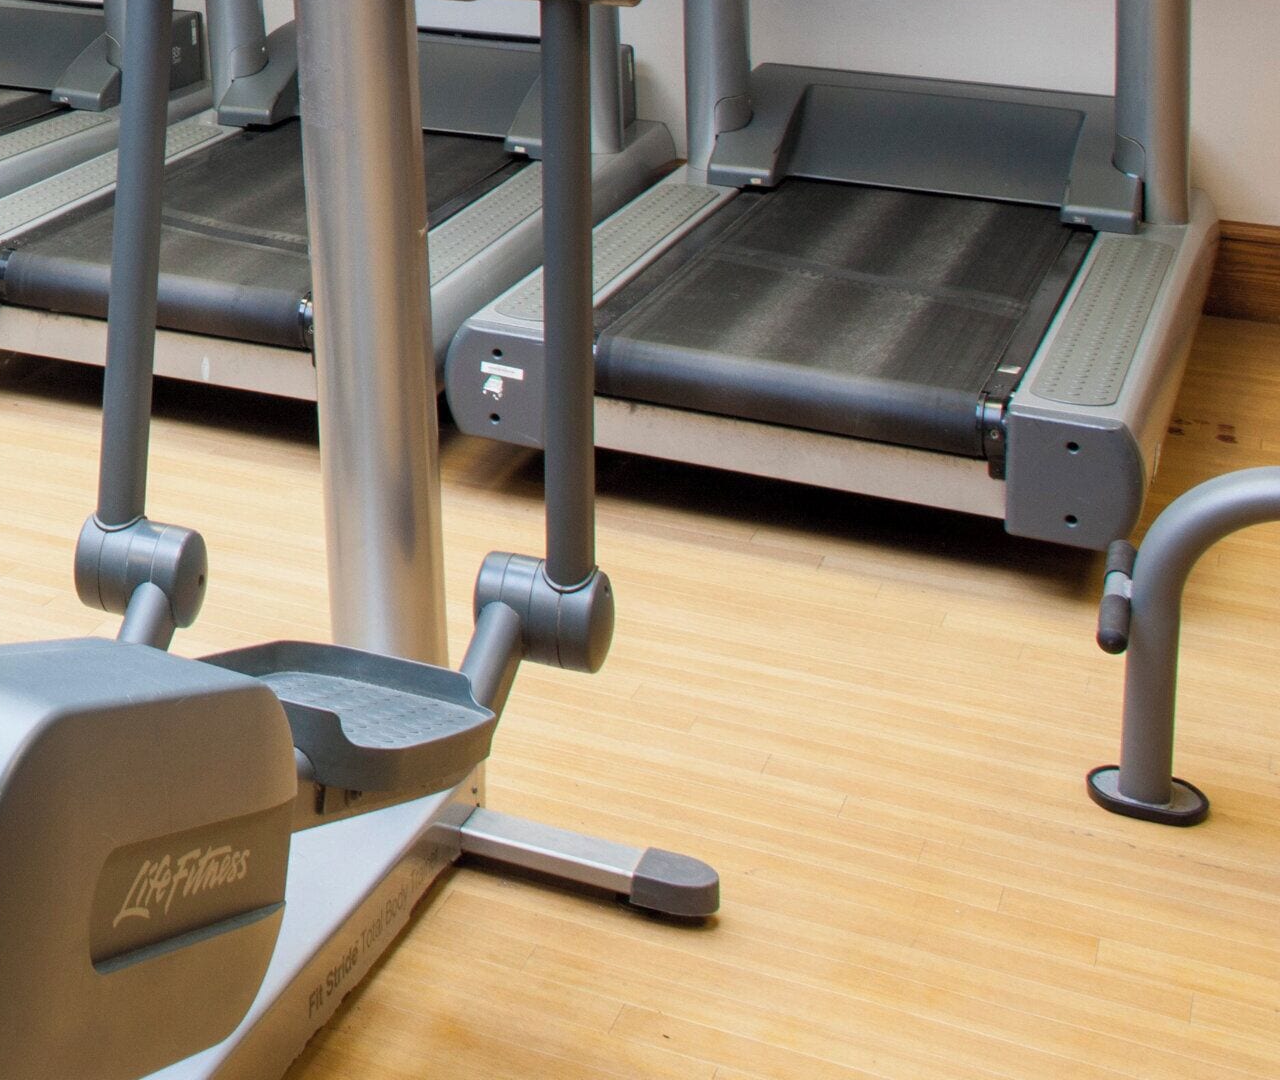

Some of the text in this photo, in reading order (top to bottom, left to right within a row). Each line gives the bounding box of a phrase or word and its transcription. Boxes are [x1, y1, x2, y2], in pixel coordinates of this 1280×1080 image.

[113, 845, 250, 928] Life Fitness
[308, 984, 324, 1019] Fit
[326, 946, 359, 997] Stride
[361, 909, 383, 953] Total
